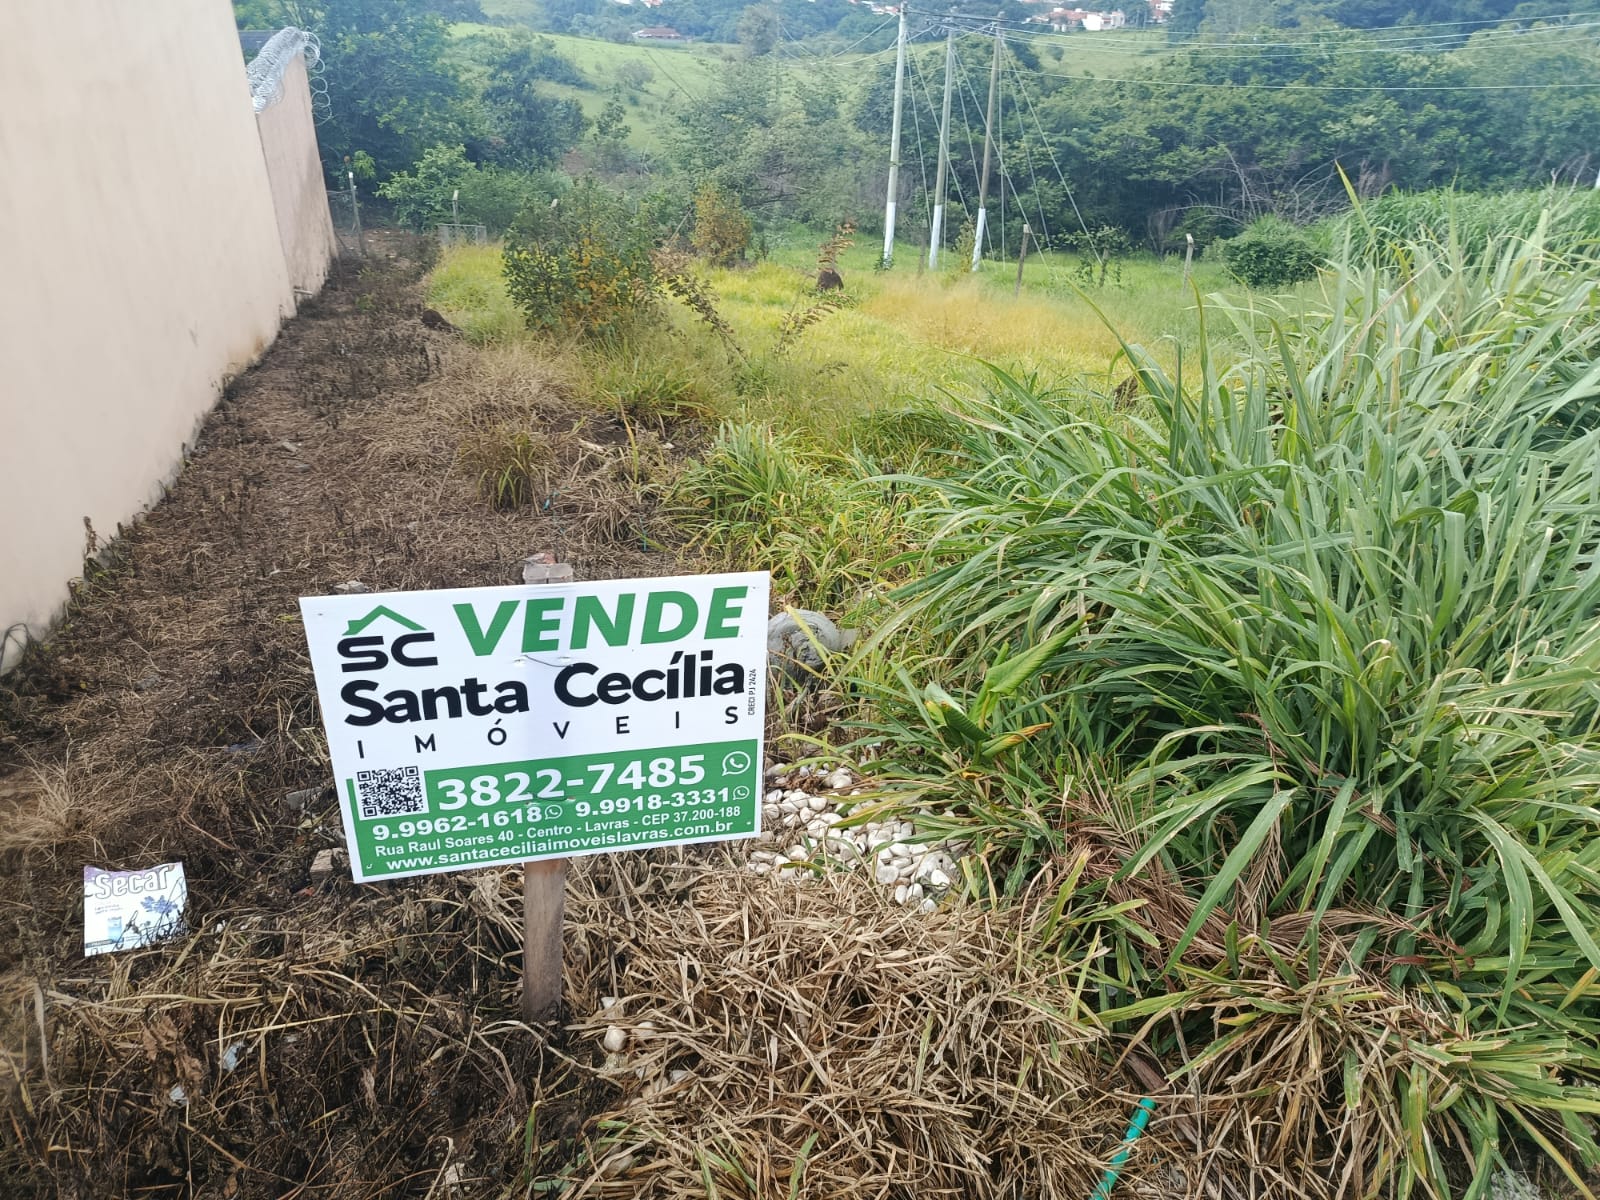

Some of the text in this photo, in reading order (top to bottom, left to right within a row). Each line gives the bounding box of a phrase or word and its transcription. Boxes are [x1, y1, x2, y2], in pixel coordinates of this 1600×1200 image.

[452, 586, 748, 656] VENDE
[337, 632, 438, 672] SC
[341, 650, 744, 726] Santa Cecília
[747, 696, 756, 716] CRECI
[357, 706, 738, 759] IMÓVEIS
[437, 754, 705, 811] 3822-7485
[372, 787, 729, 840] 9.9962-1618 9.9918-3331
[375, 844, 404, 857] Rua
[408, 839, 440, 853] Raul
[445, 833, 494, 849] Soares
[498, 830, 514, 842] 40
[527, 823, 573, 839] Centro
[585, 818, 630, 833] Lavras
[642, 813, 670, 826] CEP
[673, 806, 741, 823] 37.200-188
[386, 820, 733, 871] www.santaceciliaimoveislavras.com.br
[95, 865, 169, 899] Secar
